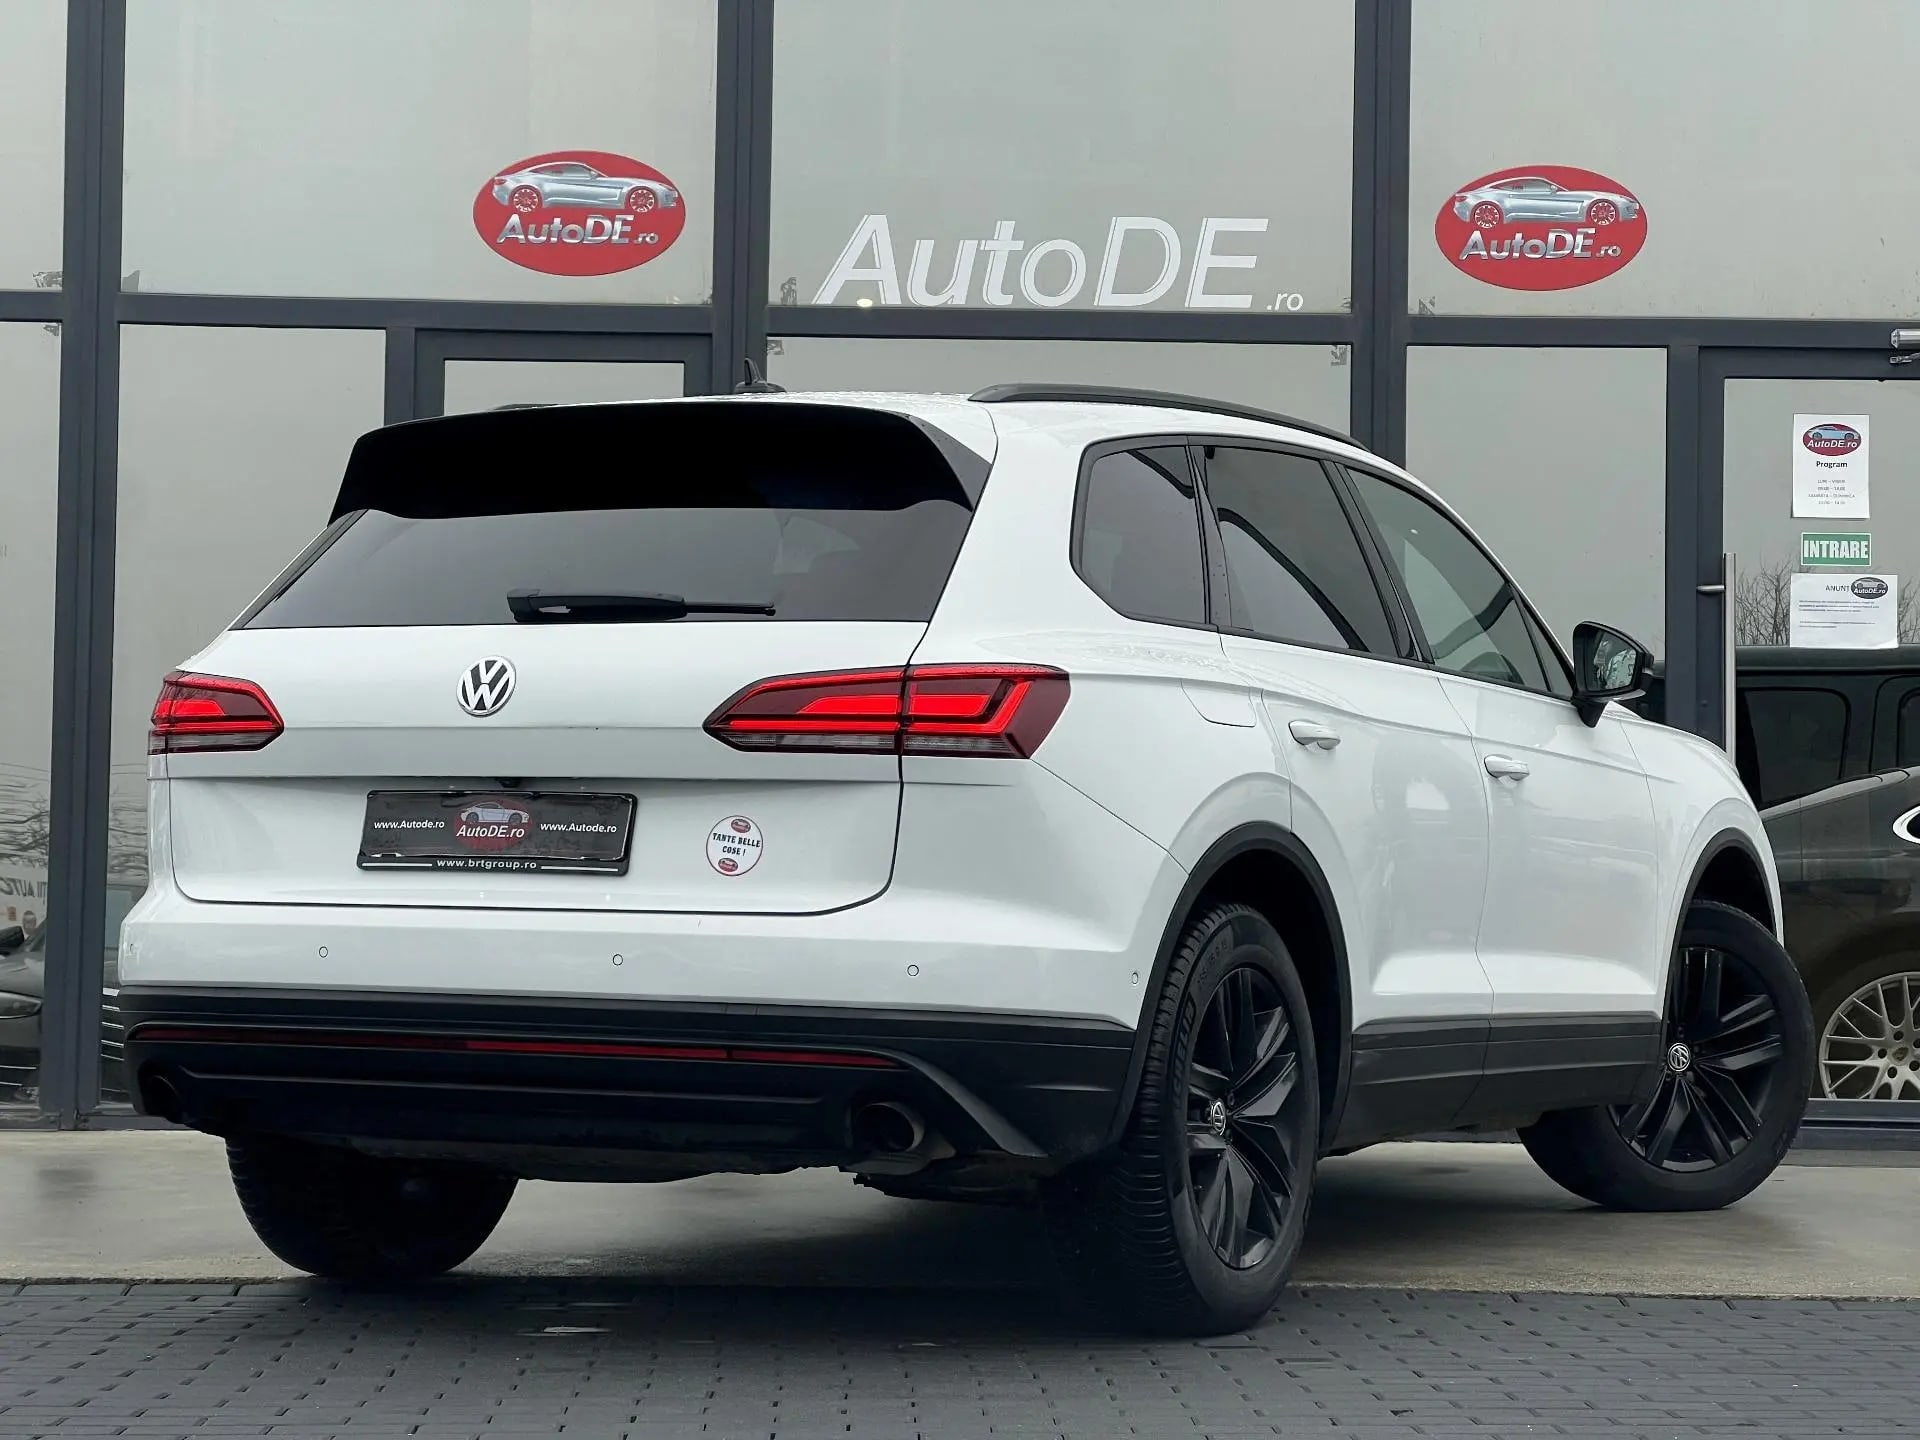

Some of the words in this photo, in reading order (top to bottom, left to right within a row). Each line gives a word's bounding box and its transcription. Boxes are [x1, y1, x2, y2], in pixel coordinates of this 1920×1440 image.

[1816, 461, 1848, 469] Program
[1803, 540, 1869, 559] INTRARE
[459, 656, 514, 715] VW
[374, 820, 445, 829] www.Autode.ro
[456, 825, 525, 838] AutoDE.ro
[540, 823, 617, 833] www.Autode.ro
[712, 832, 736, 844] TANTE
[737, 836, 761, 848] BELLE
[722, 845, 741, 855] COSE
[436, 859, 537, 870] www.brtgroup.ro
